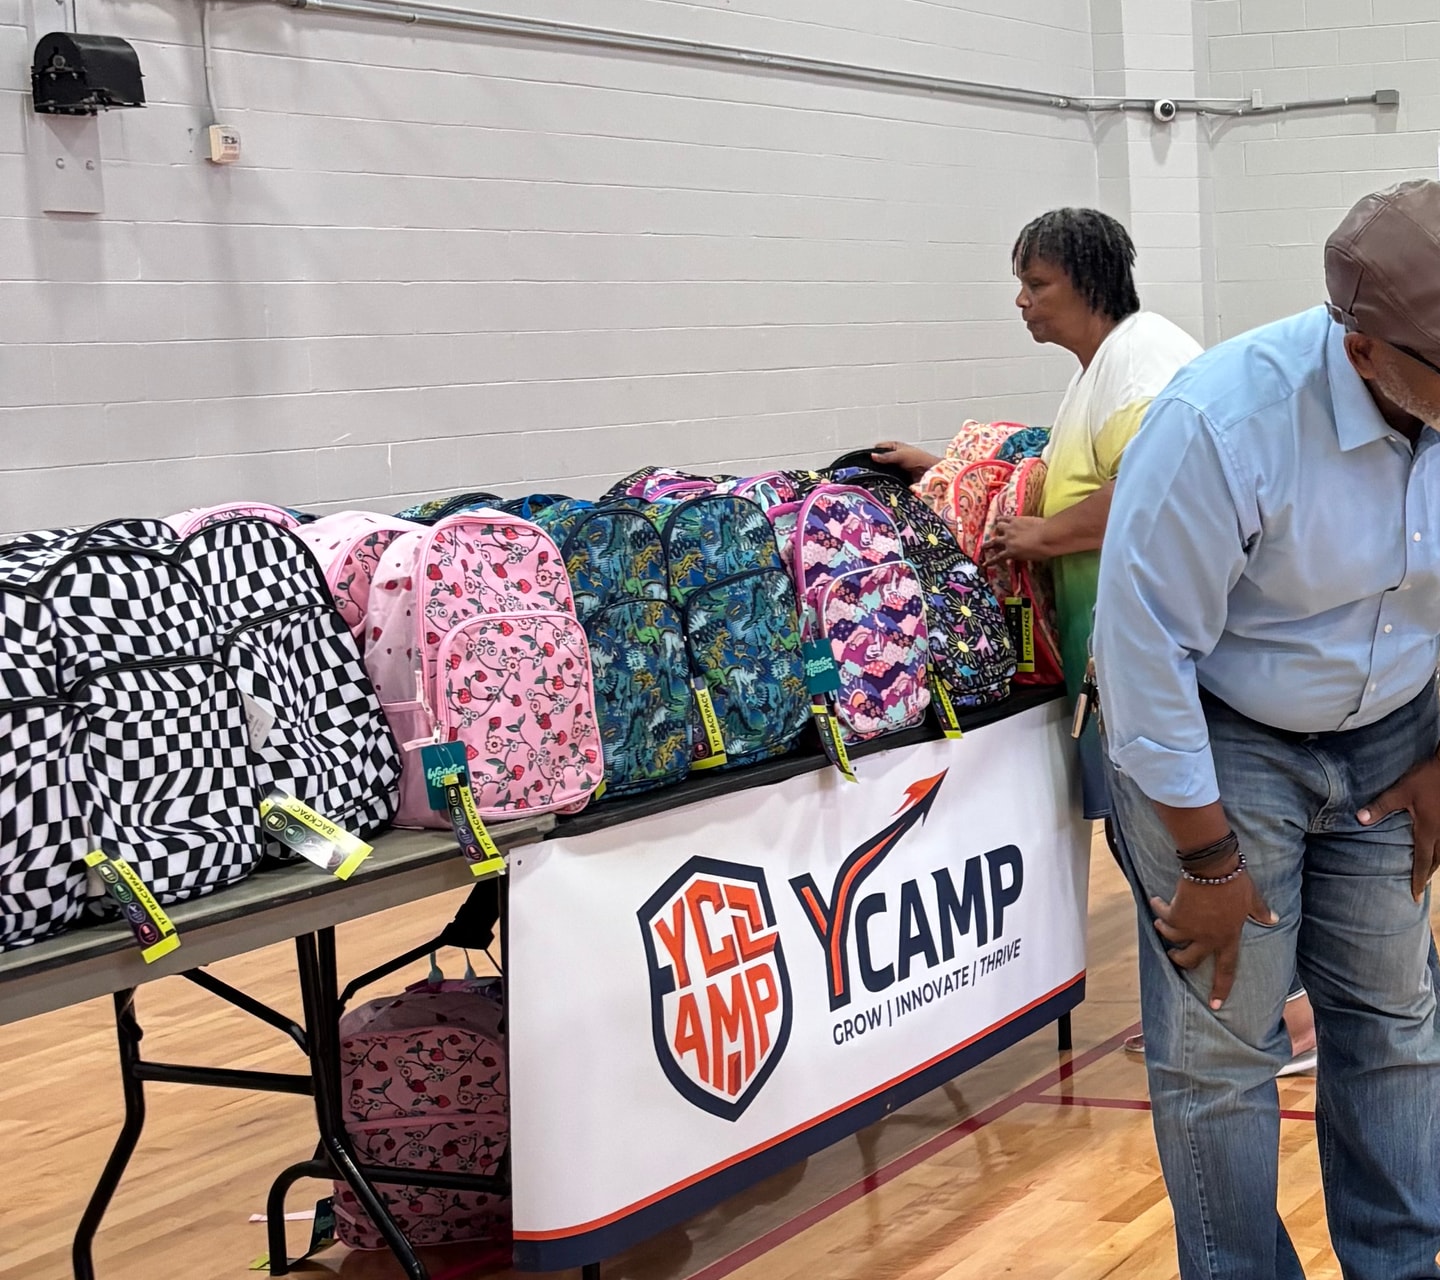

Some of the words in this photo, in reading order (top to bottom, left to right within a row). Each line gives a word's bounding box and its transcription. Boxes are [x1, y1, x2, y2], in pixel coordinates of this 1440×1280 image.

[700, 691, 717, 733] BACKPACK
[462, 790, 486, 837] BACKPACK
[118, 861, 157, 911] BACKPACK
[788, 800, 1024, 1012] YCAMP
[674, 962, 780, 1097] AMP
[833, 1004, 881, 1046] GROW
[896, 965, 970, 1018] INNOVATE
[979, 938, 1022, 977] THRIVE
